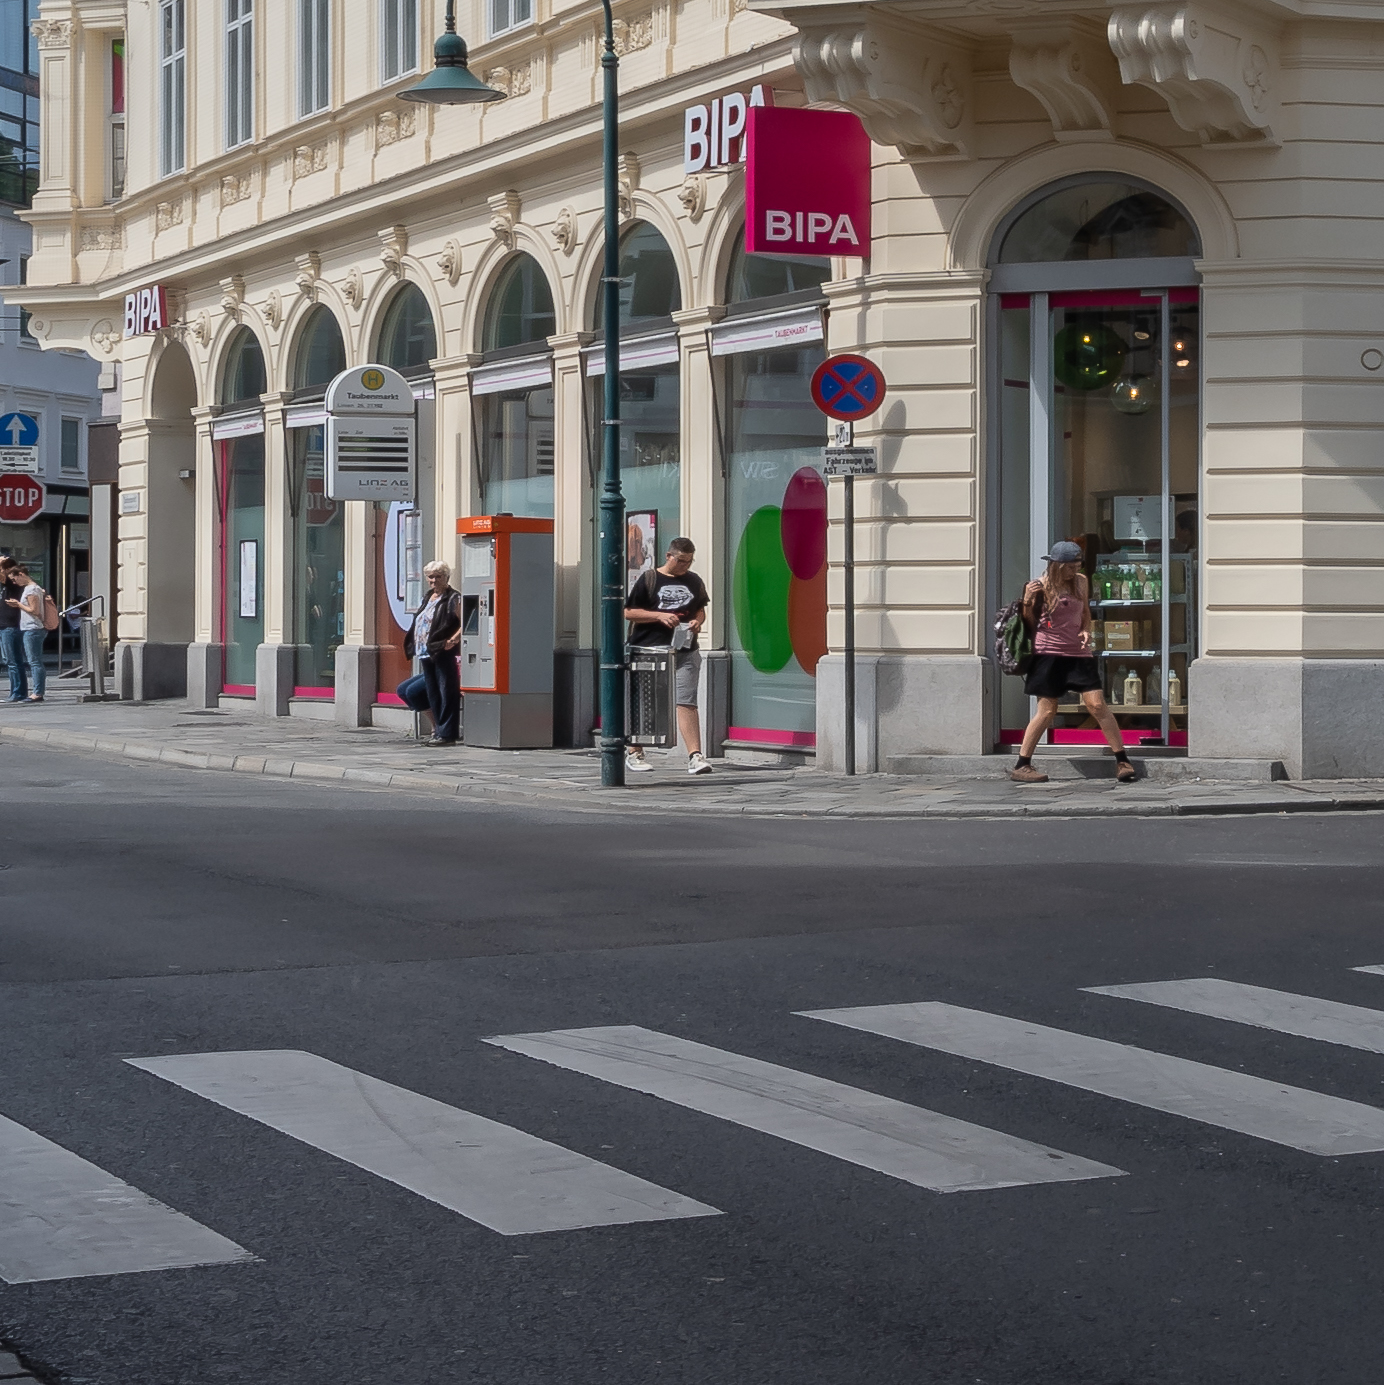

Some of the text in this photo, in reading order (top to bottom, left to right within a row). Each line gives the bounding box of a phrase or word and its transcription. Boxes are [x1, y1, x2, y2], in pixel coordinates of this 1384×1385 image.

[765, 209, 860, 246] BIPA
[124, 284, 163, 338] BIPA
[346, 392, 400, 401] Taubenmarkt
[823, 466, 837, 475] AST
[849, 466, 877, 474] Verkehr
[390, 479, 409, 487] AG
[0, 487, 39, 507] TOP
